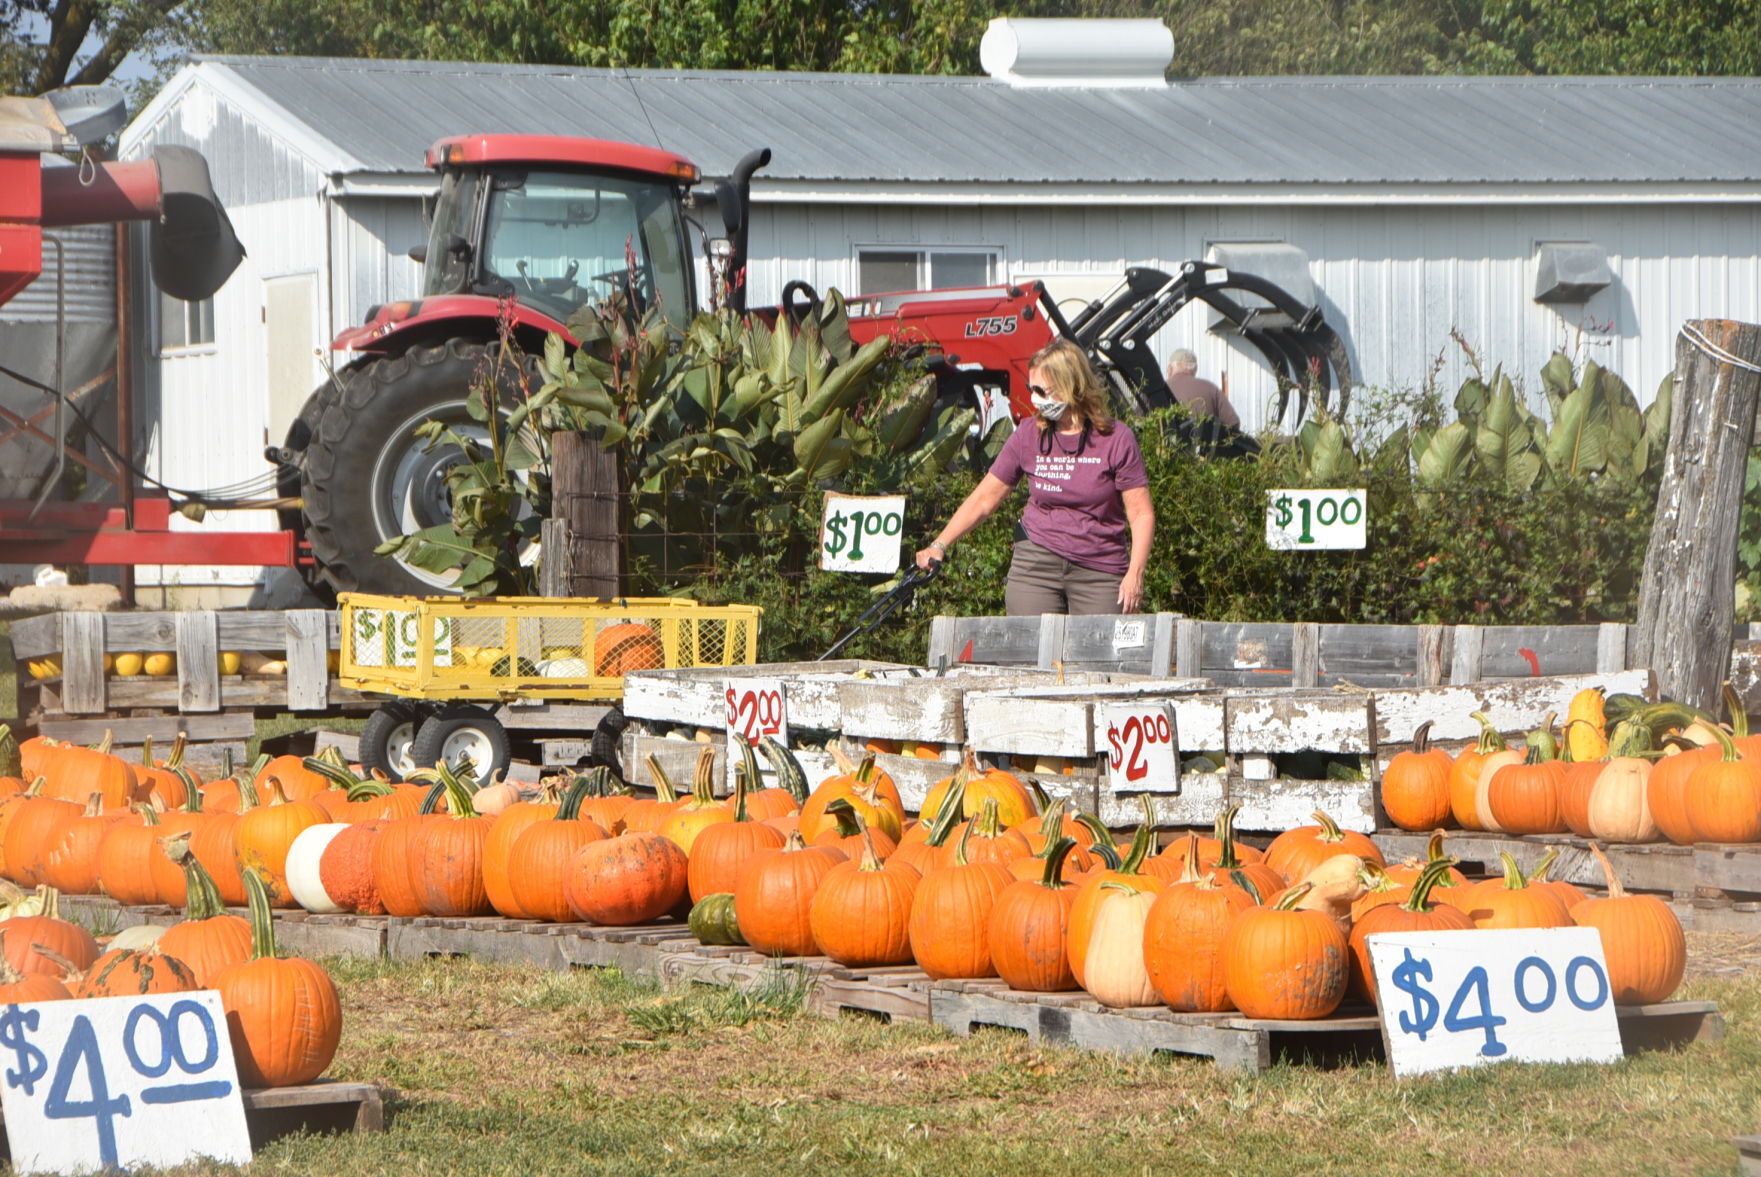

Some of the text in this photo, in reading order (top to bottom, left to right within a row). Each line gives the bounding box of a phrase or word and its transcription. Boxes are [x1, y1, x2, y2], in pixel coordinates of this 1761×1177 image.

[965, 316, 1017, 338] L755
[1077, 456, 1101, 464] where
[1035, 464, 1047, 472] you
[1043, 483, 1062, 492] kind.
